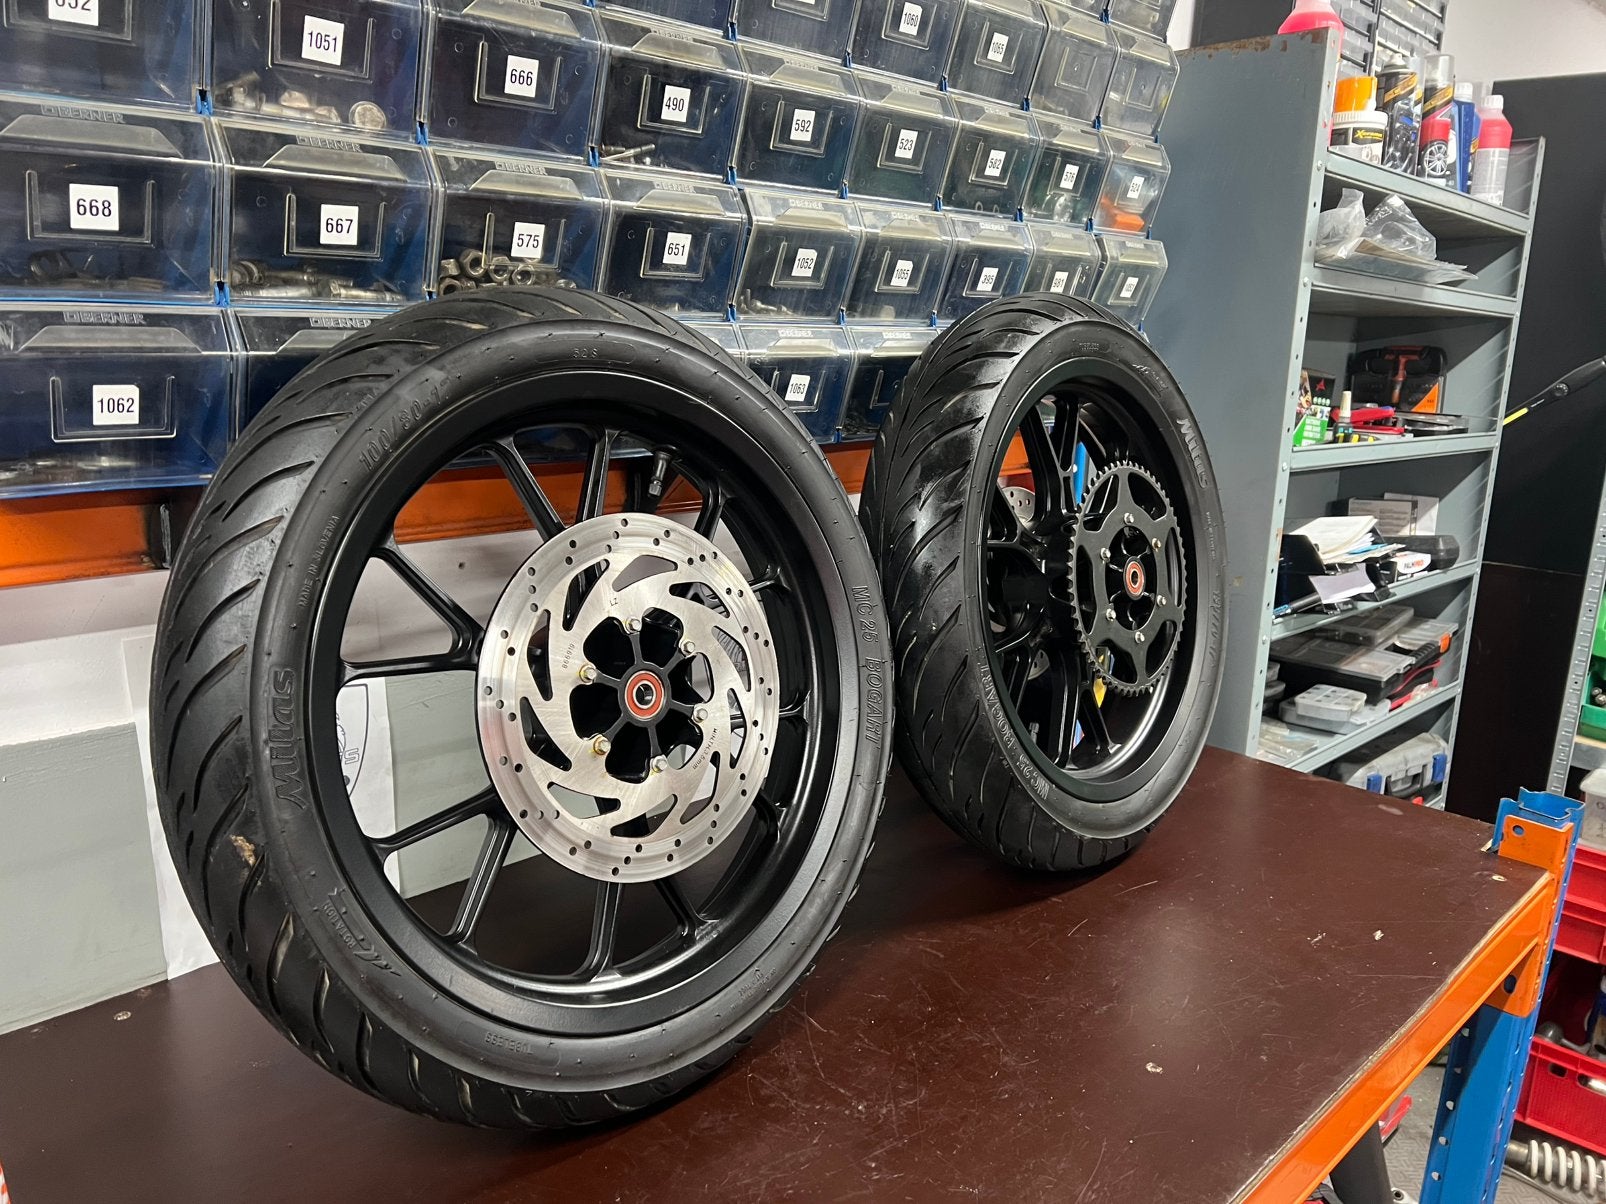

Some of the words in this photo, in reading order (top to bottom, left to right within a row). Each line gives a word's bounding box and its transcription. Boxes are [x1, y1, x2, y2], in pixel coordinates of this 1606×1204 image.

[307, 31, 338, 53] 1051
[509, 67, 534, 88] 666
[664, 97, 685, 113] 490
[794, 118, 811, 133] 592
[898, 138, 914, 151] 523
[75, 199, 112, 218] 668
[325, 218, 353, 235] 667
[516, 233, 541, 249] 575
[667, 241, 686, 257] 651
[796, 257, 813, 271] 1052
[789, 381, 806, 395] 1063
[97, 397, 135, 413] 1062
[852, 585, 873, 615] MC
[860, 619, 879, 643] 25
[864, 656, 884, 750] BOGART
[322, 902, 356, 949] ROTATION
[485, 1031, 534, 1055] TUBELESS
